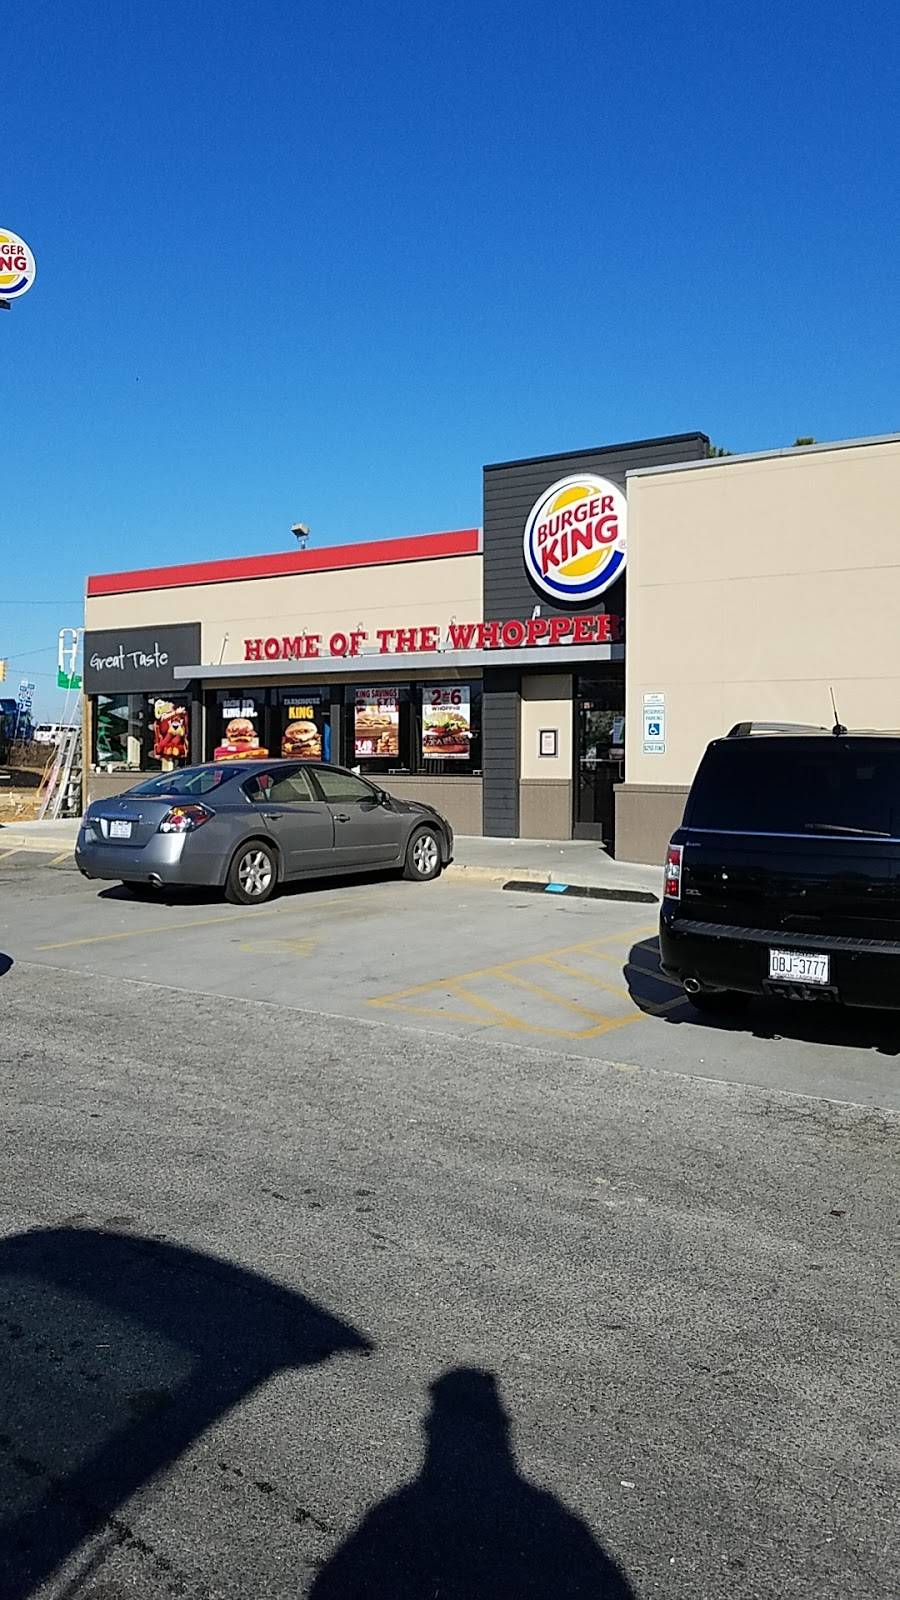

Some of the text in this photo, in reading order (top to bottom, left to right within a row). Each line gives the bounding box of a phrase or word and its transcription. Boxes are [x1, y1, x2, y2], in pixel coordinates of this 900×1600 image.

[537, 495, 615, 547] BURGER
[541, 514, 619, 575] KING
[244, 614, 621, 661] HOME OF THE WHOPPER
[89, 641, 169, 671] Great Taste
[430, 688, 442, 706] 2
[450, 688, 462, 706] 6
[288, 706, 316, 720] KING
[771, 955, 827, 977] DBJ-3777
